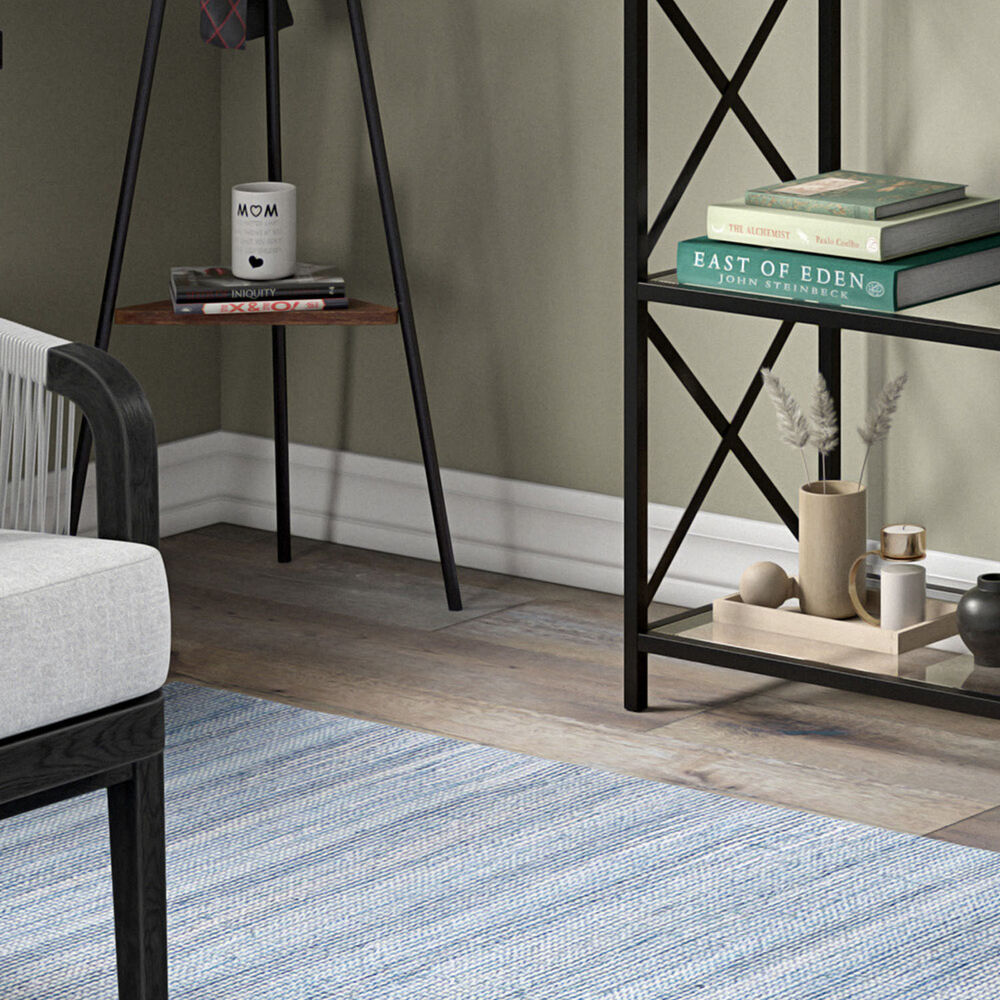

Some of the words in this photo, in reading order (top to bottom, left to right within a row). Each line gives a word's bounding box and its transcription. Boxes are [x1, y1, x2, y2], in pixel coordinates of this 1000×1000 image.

[728, 223, 744, 235] THE
[747, 225, 791, 240] ALCHEMIST
[693, 251, 750, 273] EAST
[760, 260, 790, 279] OF
[801, 265, 865, 290] EDEN
[231, 288, 276, 299] INIQUITY
[718, 274, 758, 286] JOHN
[764, 280, 849, 300] STEINBECK
